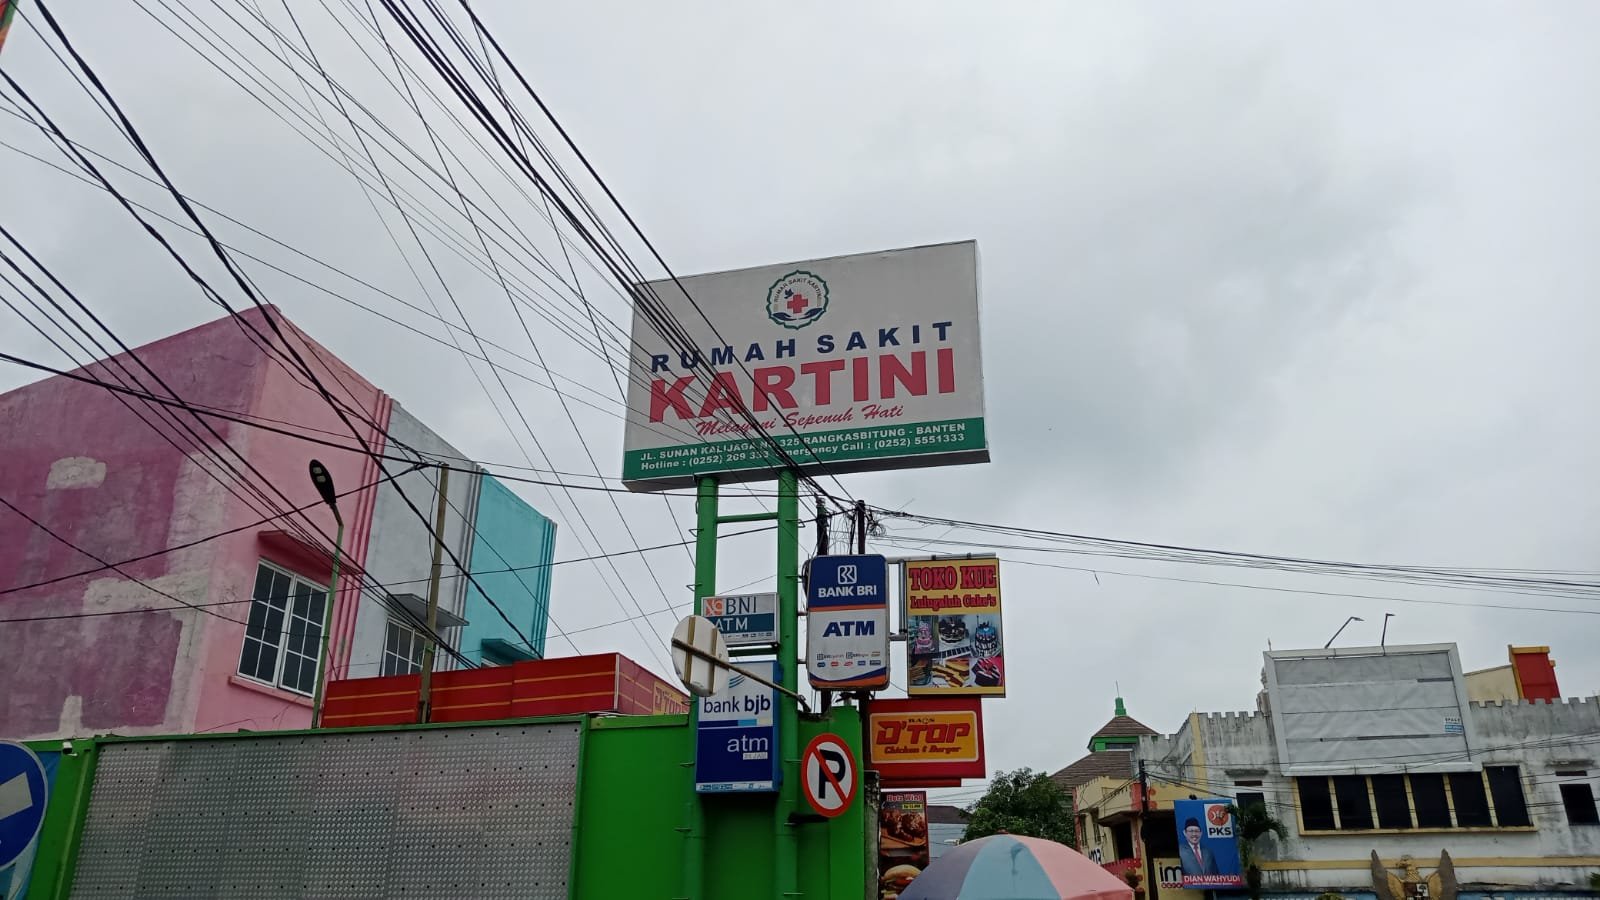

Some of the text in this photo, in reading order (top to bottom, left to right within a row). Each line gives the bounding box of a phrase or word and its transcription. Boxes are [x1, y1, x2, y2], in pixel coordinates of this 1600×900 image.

[651, 321, 953, 373] RUMAH SAKIT
[649, 347, 956, 424] KARTINI
[695, 404, 904, 436] Melayni Sepenuh Hati
[640, 452, 657, 461] JL.
[659, 447, 698, 460] SUNAN
[700, 442, 757, 455] KALIJAGA
[779, 437, 800, 447] 325
[803, 428, 906, 445] RANGKASBITUNG
[916, 423, 966, 435] BANTEN
[640, 460, 680, 471] Hotline
[688, 455, 722, 467] (0252)
[726, 452, 746, 462] 209
[775, 445, 838, 457] mergency
[841, 442, 864, 451] Call
[874, 438, 911, 451] (0252)
[914, 433, 966, 445] 5551333
[908, 564, 997, 591] TOKO KUE
[817, 584, 877, 598] BANK BRI
[725, 596, 757, 615] BNI
[714, 616, 748, 631] ATM
[822, 620, 875, 638] ATM
[703, 694, 771, 715] bank bjb
[875, 720, 971, 745] D'TOP
[727, 734, 769, 753] atm
[928, 745, 962, 755] Burger
[818, 748, 846, 799] P
[1208, 826, 1232, 836] PKS
[1183, 875, 1203, 883] DIAN
